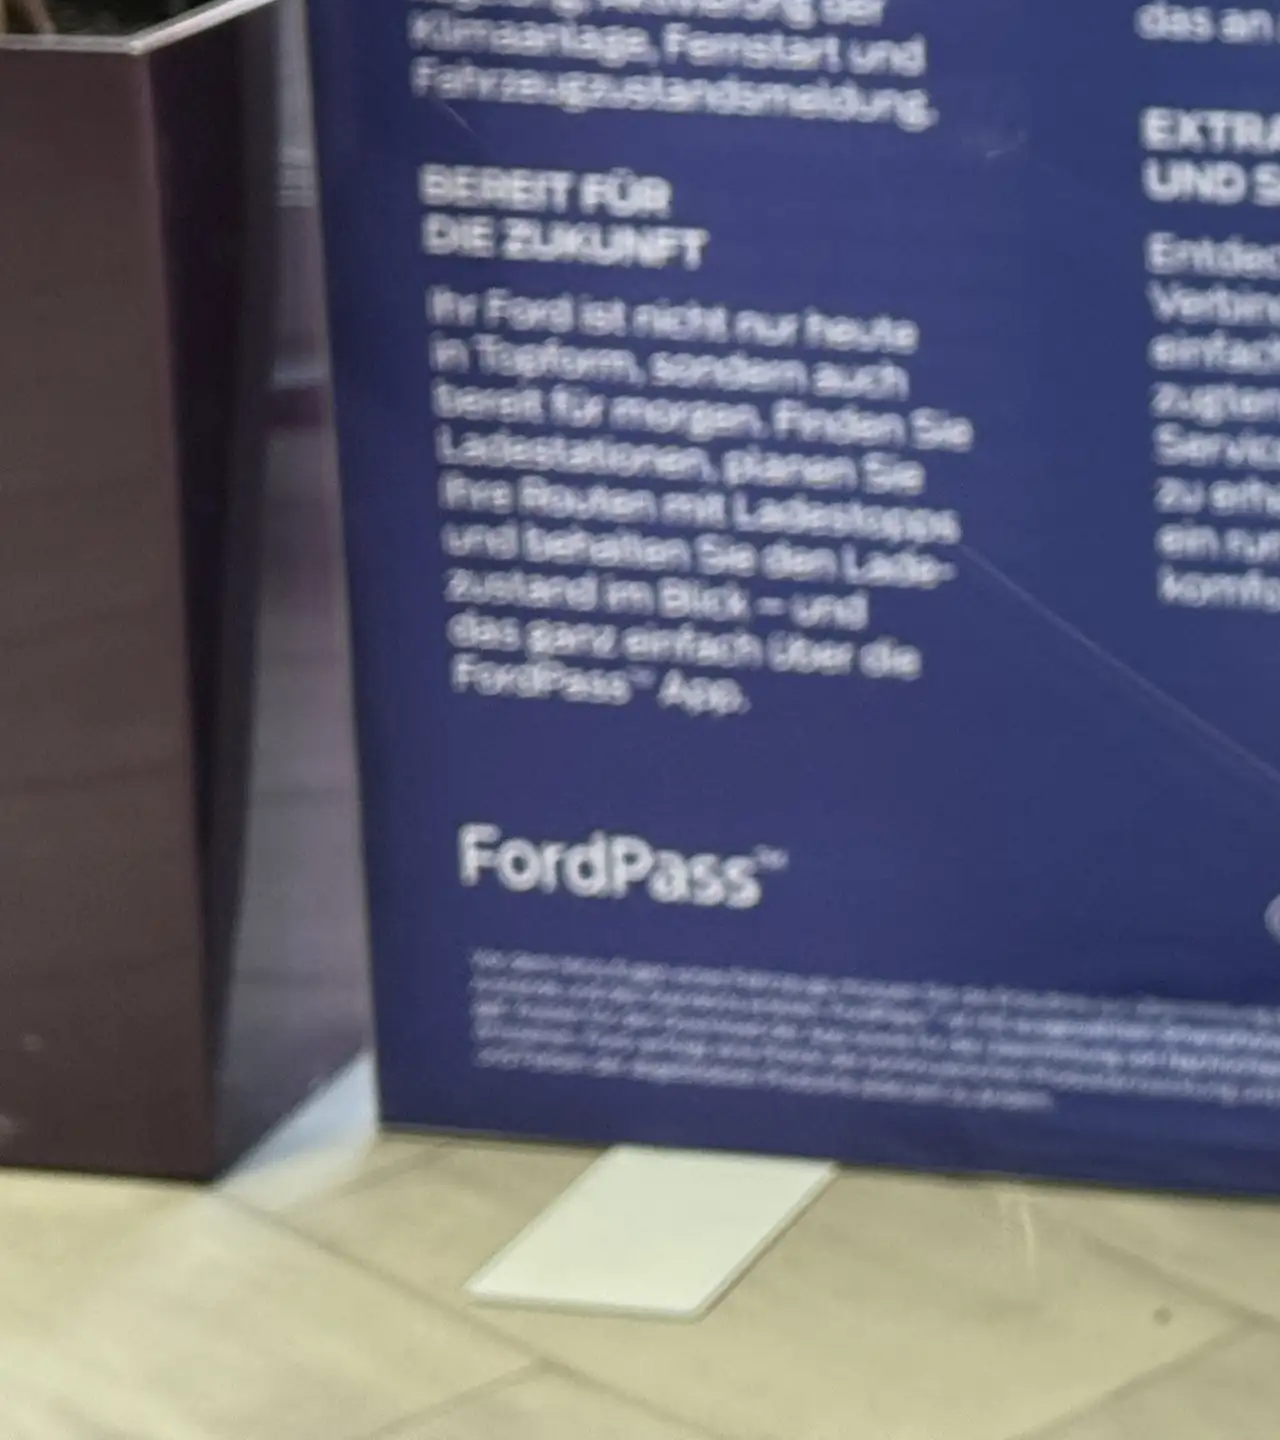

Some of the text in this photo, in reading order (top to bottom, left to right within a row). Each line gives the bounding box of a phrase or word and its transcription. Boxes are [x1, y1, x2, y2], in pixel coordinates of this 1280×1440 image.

[1136, 0, 1216, 41] das
[1215, 9, 1274, 43] an
[847, 37, 926, 76] und
[420, 164, 672, 217] BEREIT FÜR
[1143, 159, 1248, 204] UND
[423, 213, 709, 269] DIE ZUKUNFT
[484, 288, 576, 333] Ford
[578, 300, 627, 336] ist
[632, 302, 730, 342] nicht
[733, 311, 800, 346] nur
[804, 310, 918, 354] heute
[429, 333, 472, 372] in
[809, 361, 909, 399] auch
[772, 396, 906, 446] Finden
[910, 408, 973, 451] Sie
[721, 444, 858, 489] planen
[860, 452, 925, 495] Sie
[1155, 477, 1207, 513] zu
[518, 473, 660, 524] Routen
[658, 492, 727, 527] mit
[442, 520, 523, 560] und
[694, 529, 760, 576] Sie
[759, 541, 839, 581] den
[1156, 525, 1220, 559] ein
[599, 580, 656, 613] im
[655, 574, 752, 624] Blick
[788, 590, 868, 630] und
[448, 604, 523, 651] das
[859, 639, 921, 680] die
